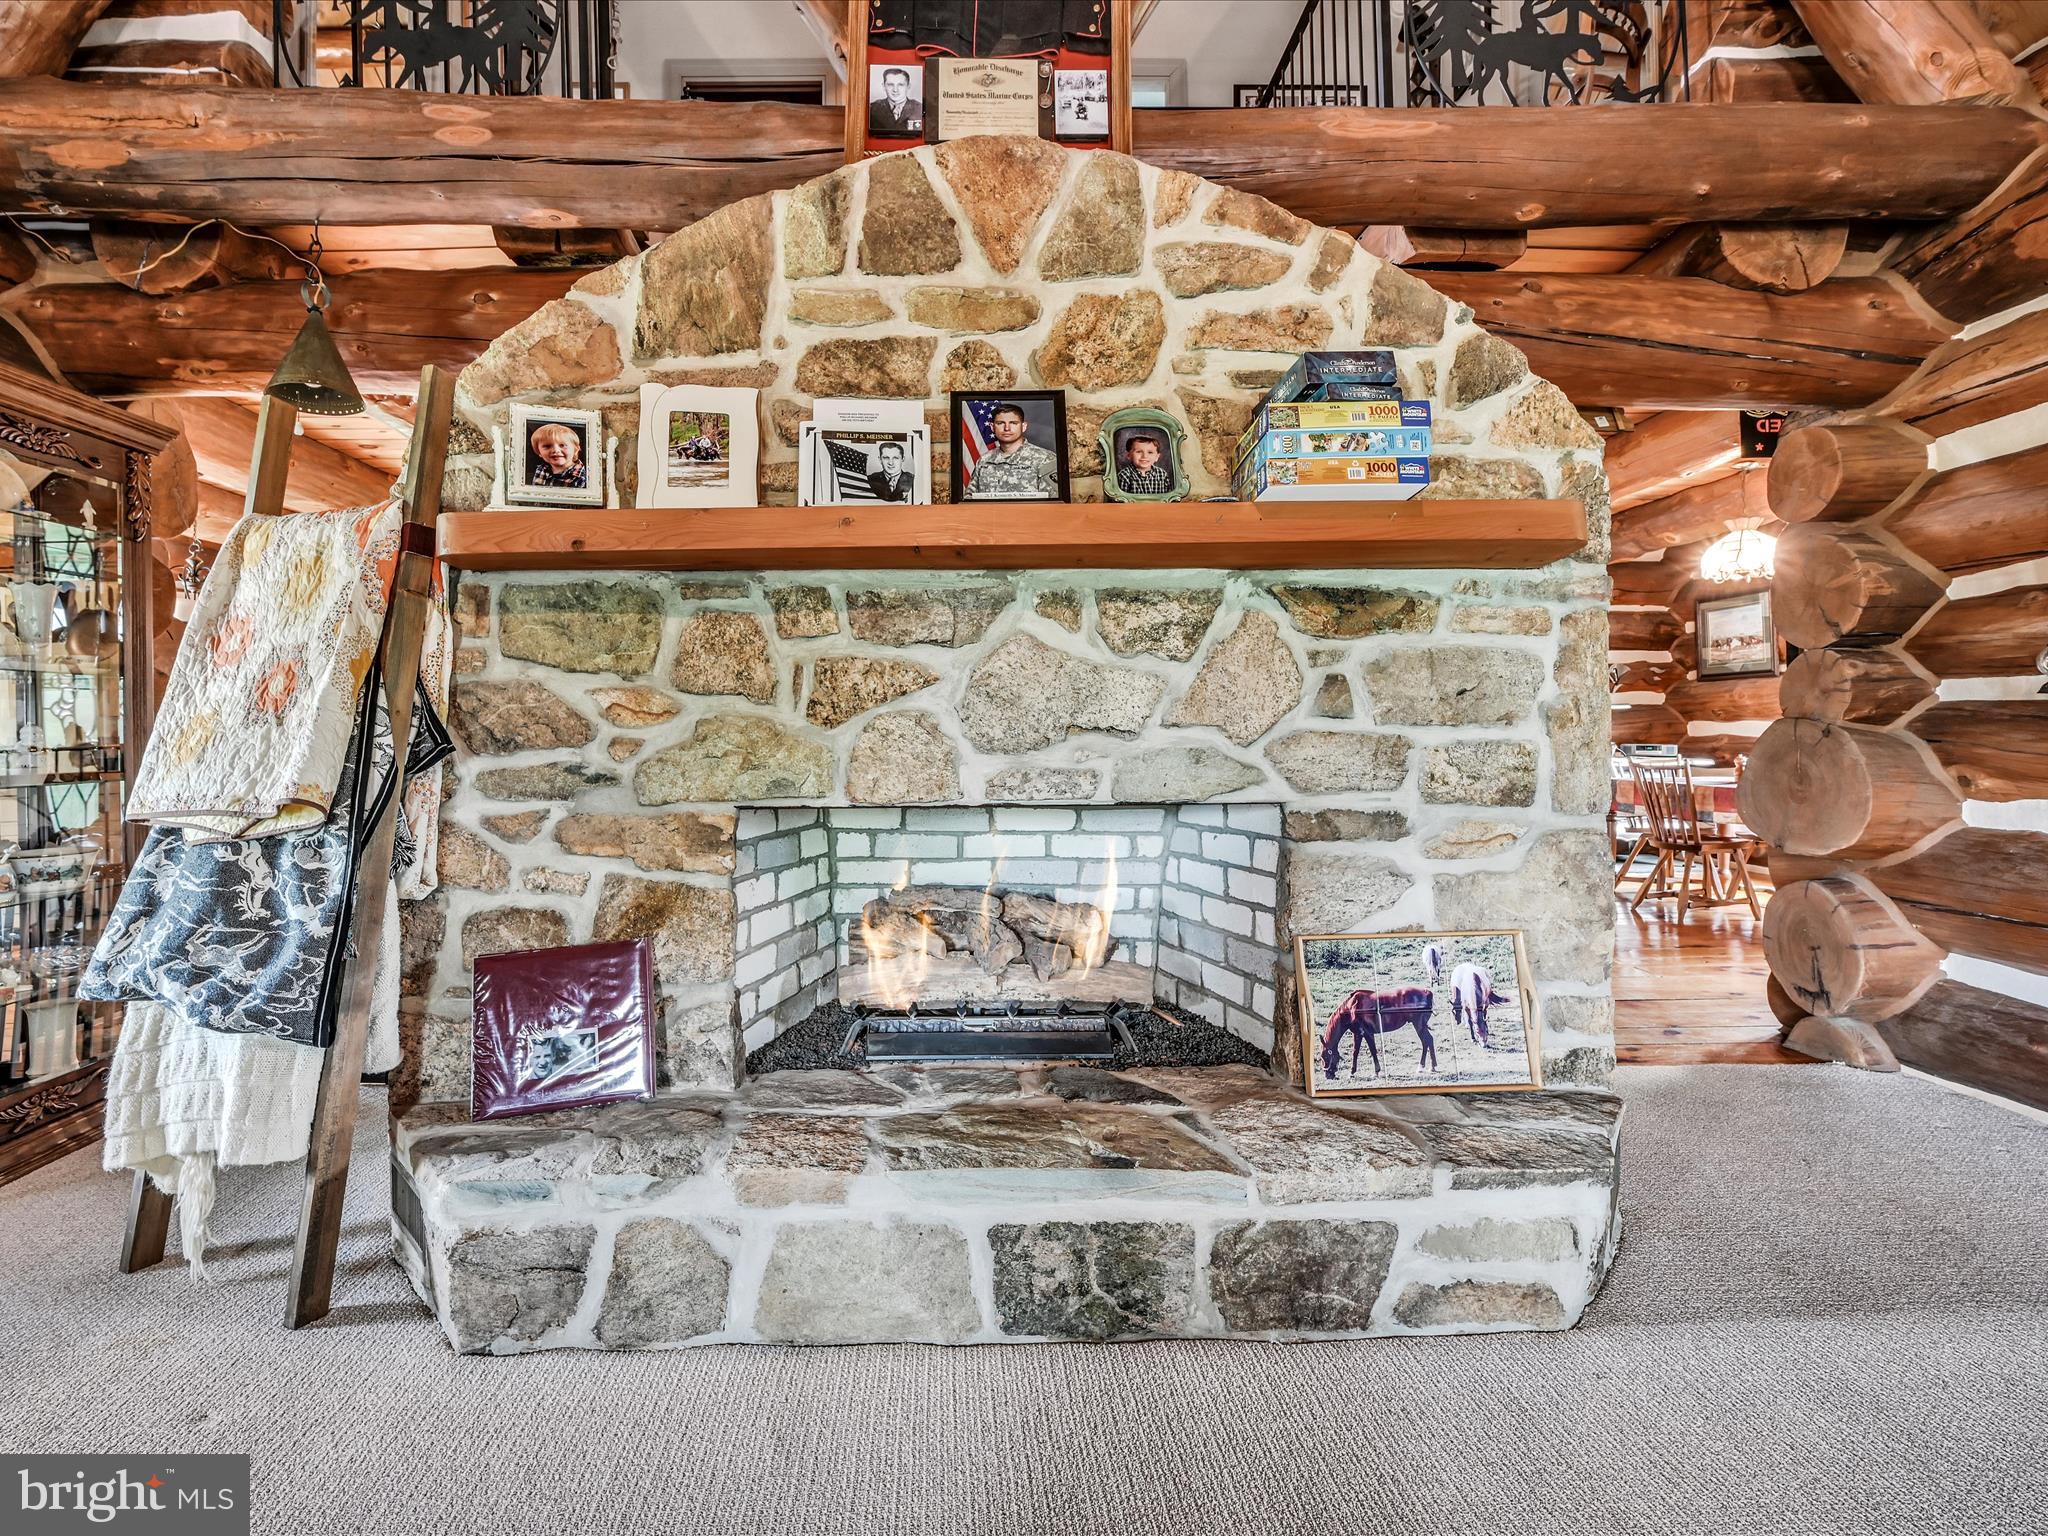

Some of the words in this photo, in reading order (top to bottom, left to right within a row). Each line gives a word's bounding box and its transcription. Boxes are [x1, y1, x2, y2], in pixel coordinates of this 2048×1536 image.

[942, 91, 964, 99] United
[965, 91, 987, 99] States
[988, 91, 1011, 99] Marine
[1012, 91, 1034, 100] Corps
[1319, 366, 1383, 374] INTERMEDIATE
[1341, 391, 1391, 400] INTERMEDIATE
[1367, 405, 1399, 416] 1000
[1282, 435, 1293, 454] 300
[1366, 462, 1396, 473] 1000
